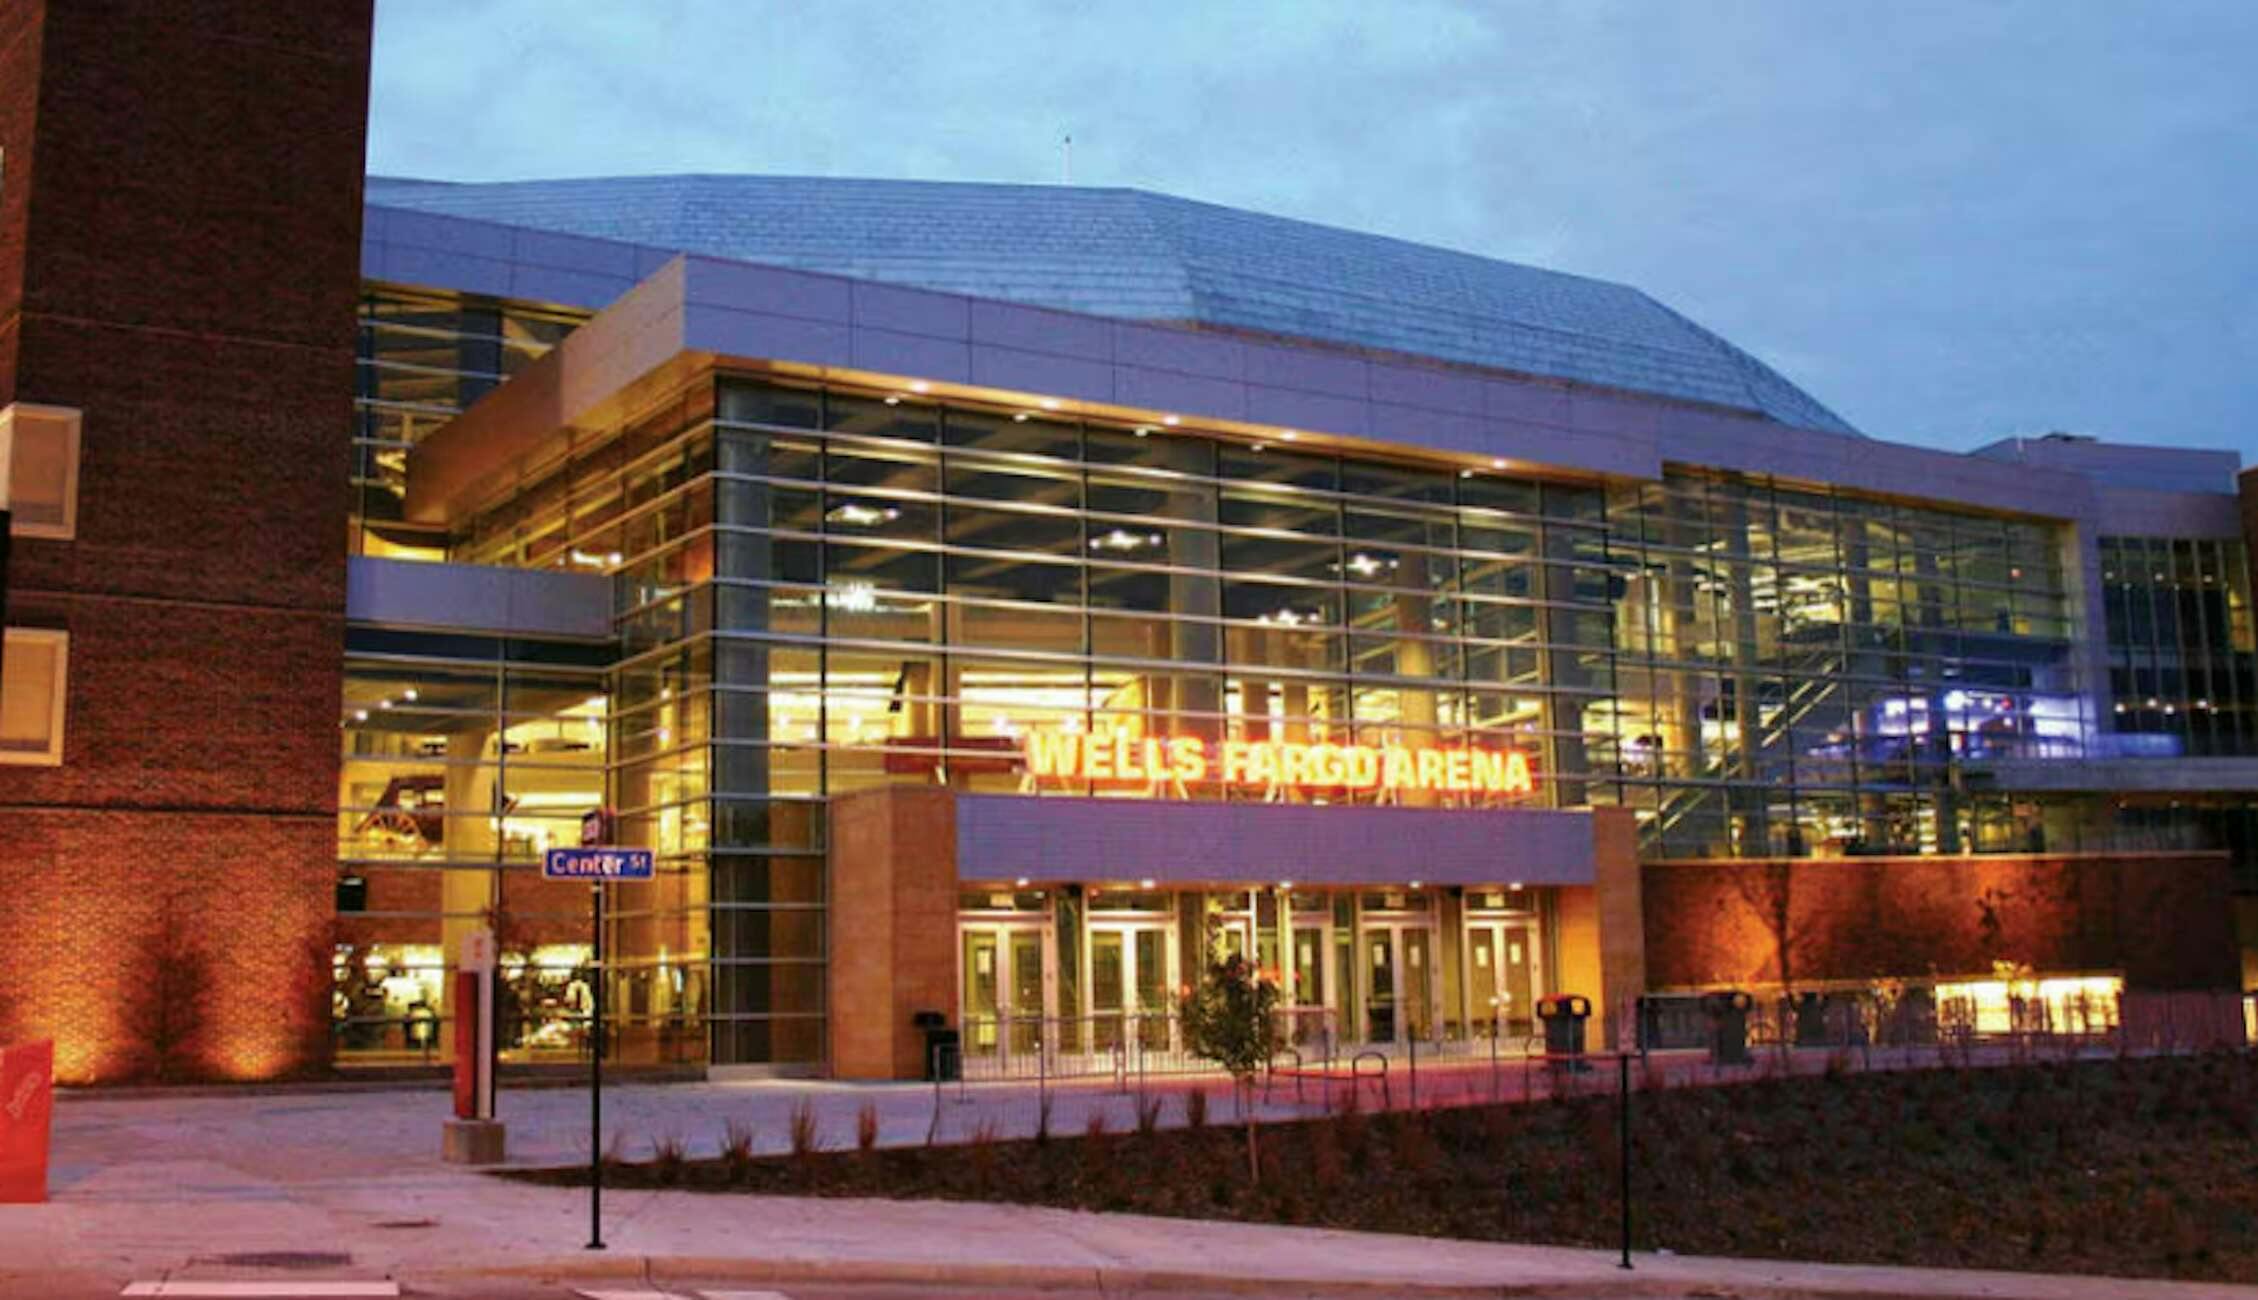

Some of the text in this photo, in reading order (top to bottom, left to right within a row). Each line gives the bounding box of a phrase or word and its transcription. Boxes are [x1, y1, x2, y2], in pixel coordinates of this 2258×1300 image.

[1027, 730, 1533, 792] WELLS FARGO ARENA
[551, 852, 624, 875] Center
